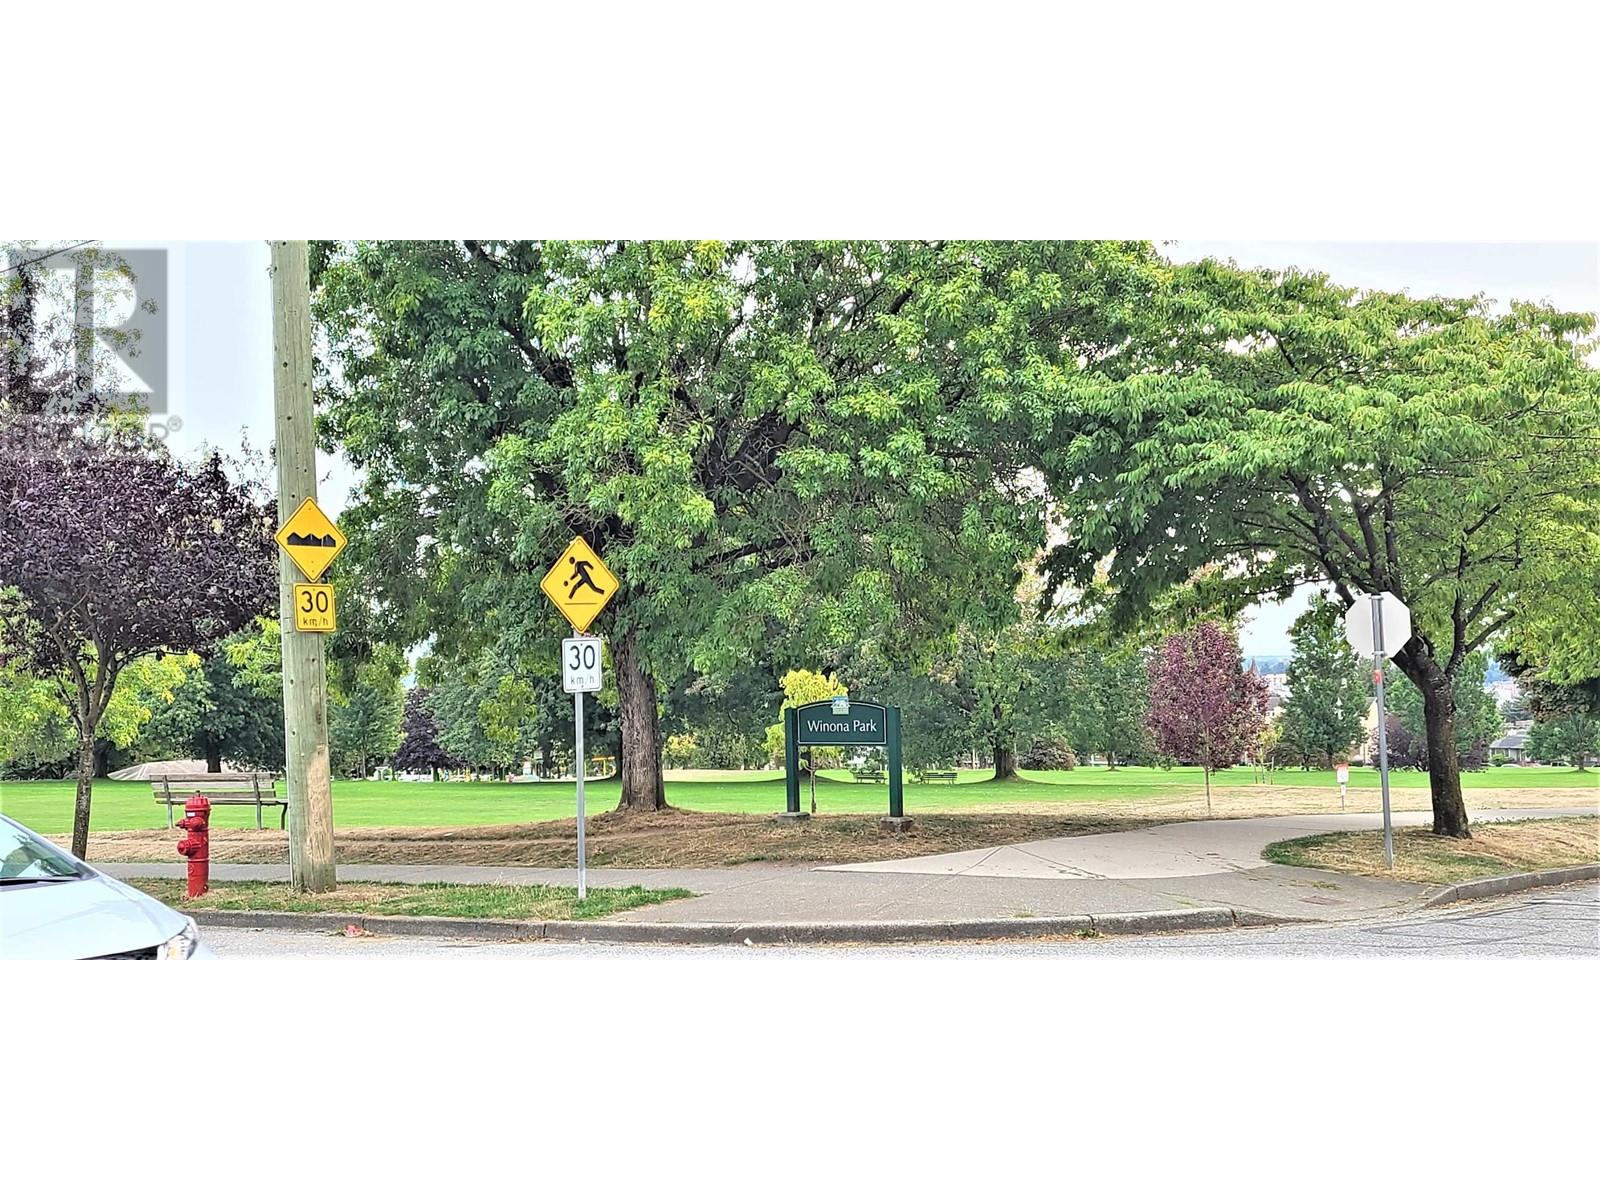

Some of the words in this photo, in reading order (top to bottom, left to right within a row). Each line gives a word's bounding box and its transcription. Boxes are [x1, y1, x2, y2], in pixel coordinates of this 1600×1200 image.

[301, 590, 328, 613] 30
[302, 616, 329, 627] km/h
[569, 645, 595, 670] 30
[570, 674, 595, 685] km/h
[807, 720, 850, 732] Winona
[853, 719, 877, 732] Park
